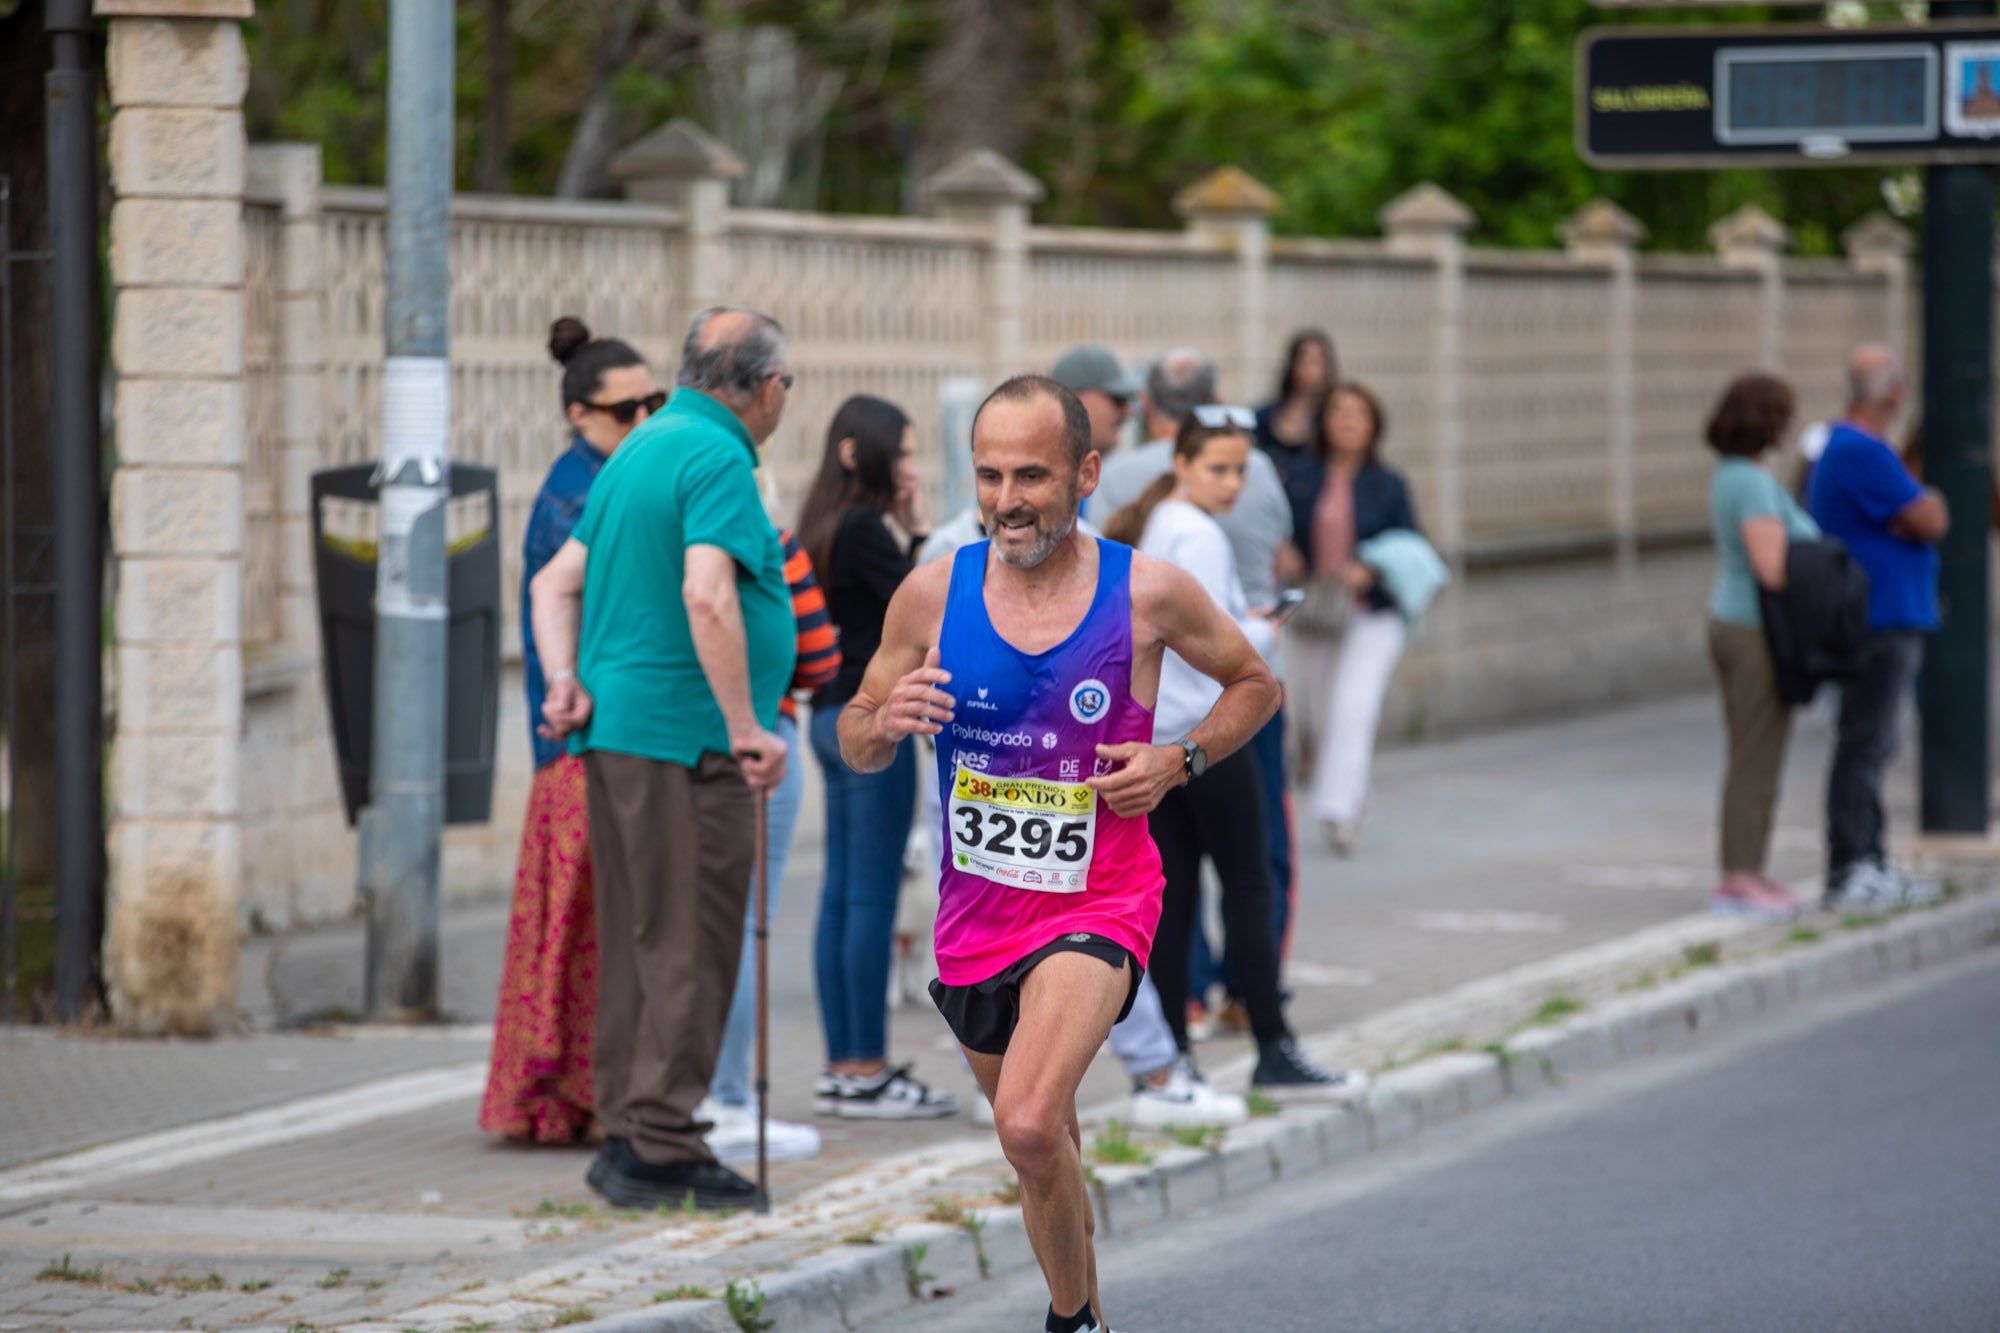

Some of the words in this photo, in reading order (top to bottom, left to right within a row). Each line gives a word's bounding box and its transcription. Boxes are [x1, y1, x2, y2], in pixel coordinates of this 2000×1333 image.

[952, 723, 1033, 747] ProIntegrada
[1060, 759, 1080, 774] DE
[969, 778, 992, 798] 38
[992, 788, 1066, 807] FONDO
[1025, 783, 1060, 794] PREMIO
[955, 806, 1087, 862] 3295
